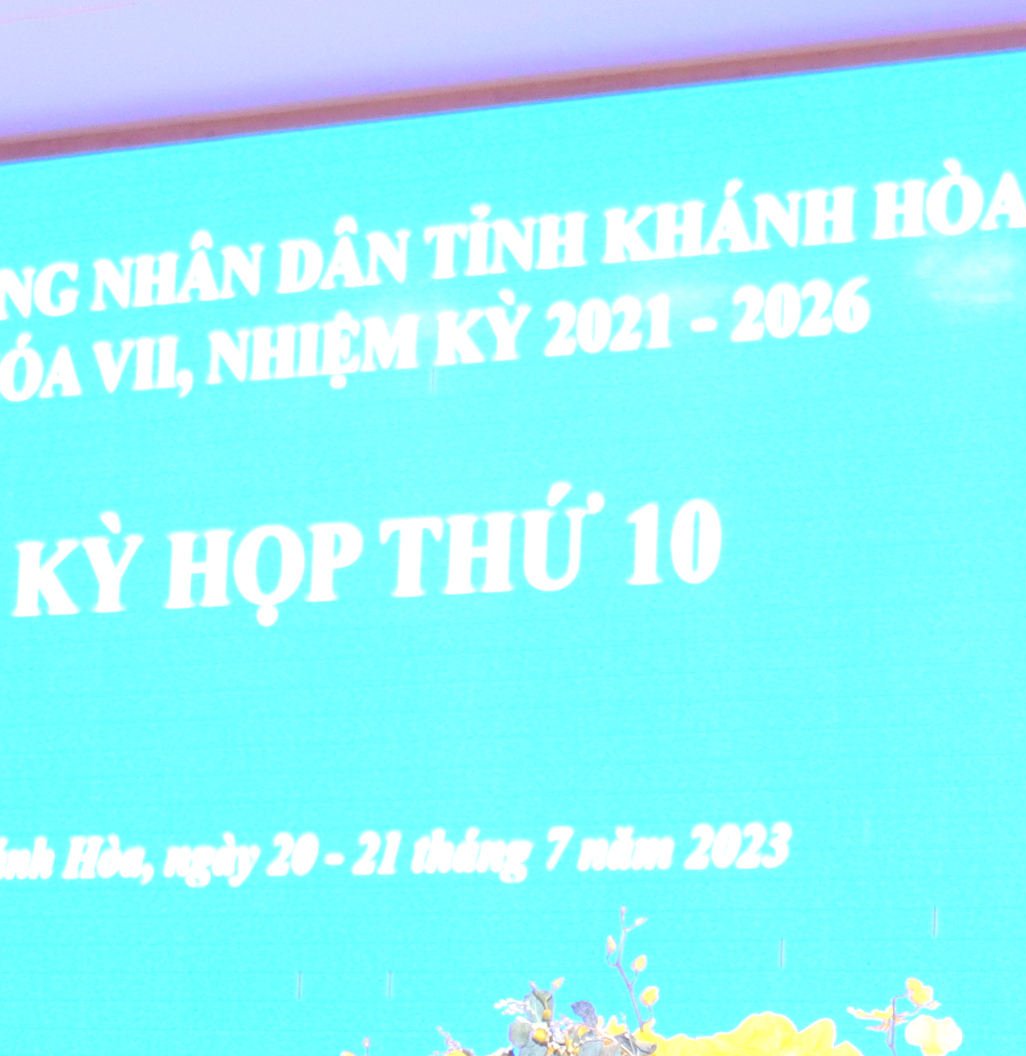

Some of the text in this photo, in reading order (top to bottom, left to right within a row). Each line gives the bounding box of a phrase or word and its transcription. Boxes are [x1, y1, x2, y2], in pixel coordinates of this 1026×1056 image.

[91, 229, 264, 312] NHÂN
[277, 215, 410, 294] DÂN
[423, 203, 587, 280] TỈNH
[601, 178, 857, 264] KHÁNH
[0, 276, 871, 402] ÓA VII, NHIỆM KỲ 2021 - 2026
[12, 481, 722, 627] KỲ HỌP THỨ 10
[61, 831, 155, 886] Hòa,
[163, 831, 261, 888] ngày
[265, 831, 320, 877] 20
[324, 852, 345, 866] -
[351, 830, 402, 876] 21
[410, 826, 534, 884] tháng
[546, 825, 575, 871] 7
[576, 825, 675, 872] năm
[683, 821, 793, 870] 2023
